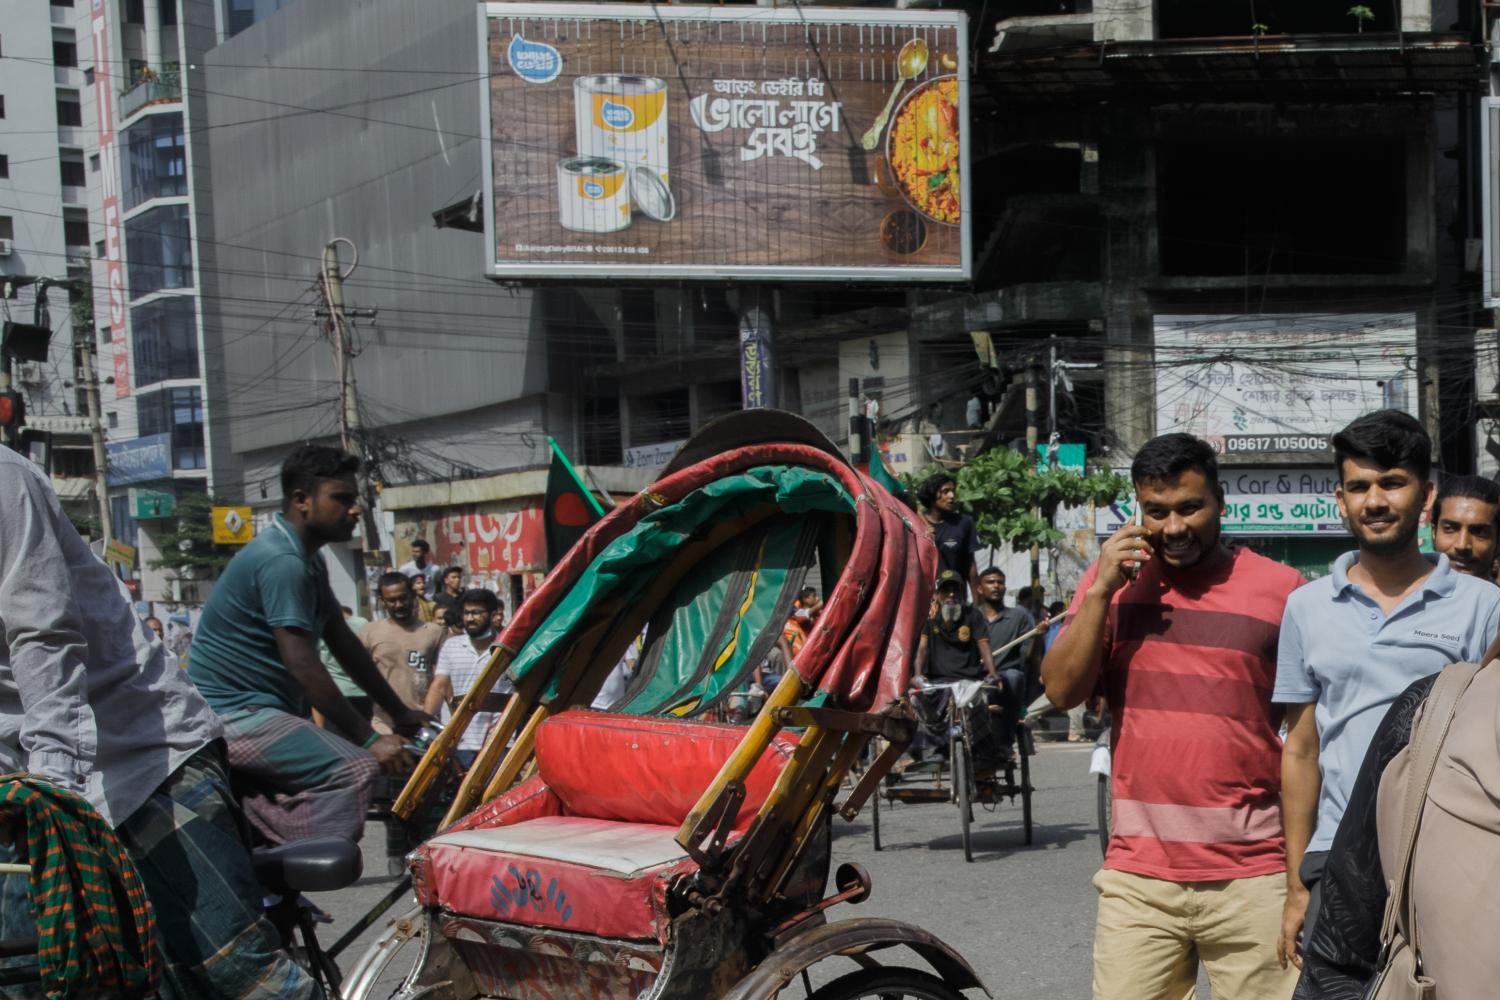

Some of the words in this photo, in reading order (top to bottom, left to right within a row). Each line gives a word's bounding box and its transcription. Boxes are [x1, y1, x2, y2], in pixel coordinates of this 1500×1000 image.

[713, 79, 757, 97] আড়ং
[761, 77, 804, 96] ডেইরি
[807, 78, 825, 96] ঘি
[690, 93, 780, 132] ভালো
[779, 100, 842, 132] লাগে
[740, 122, 824, 170] সবই
[1228, 438, 1270, 450] 09617
[1274, 437, 1327, 450] 105005
[1237, 473, 1269, 495] Car
[1276, 473, 1291, 494] &
